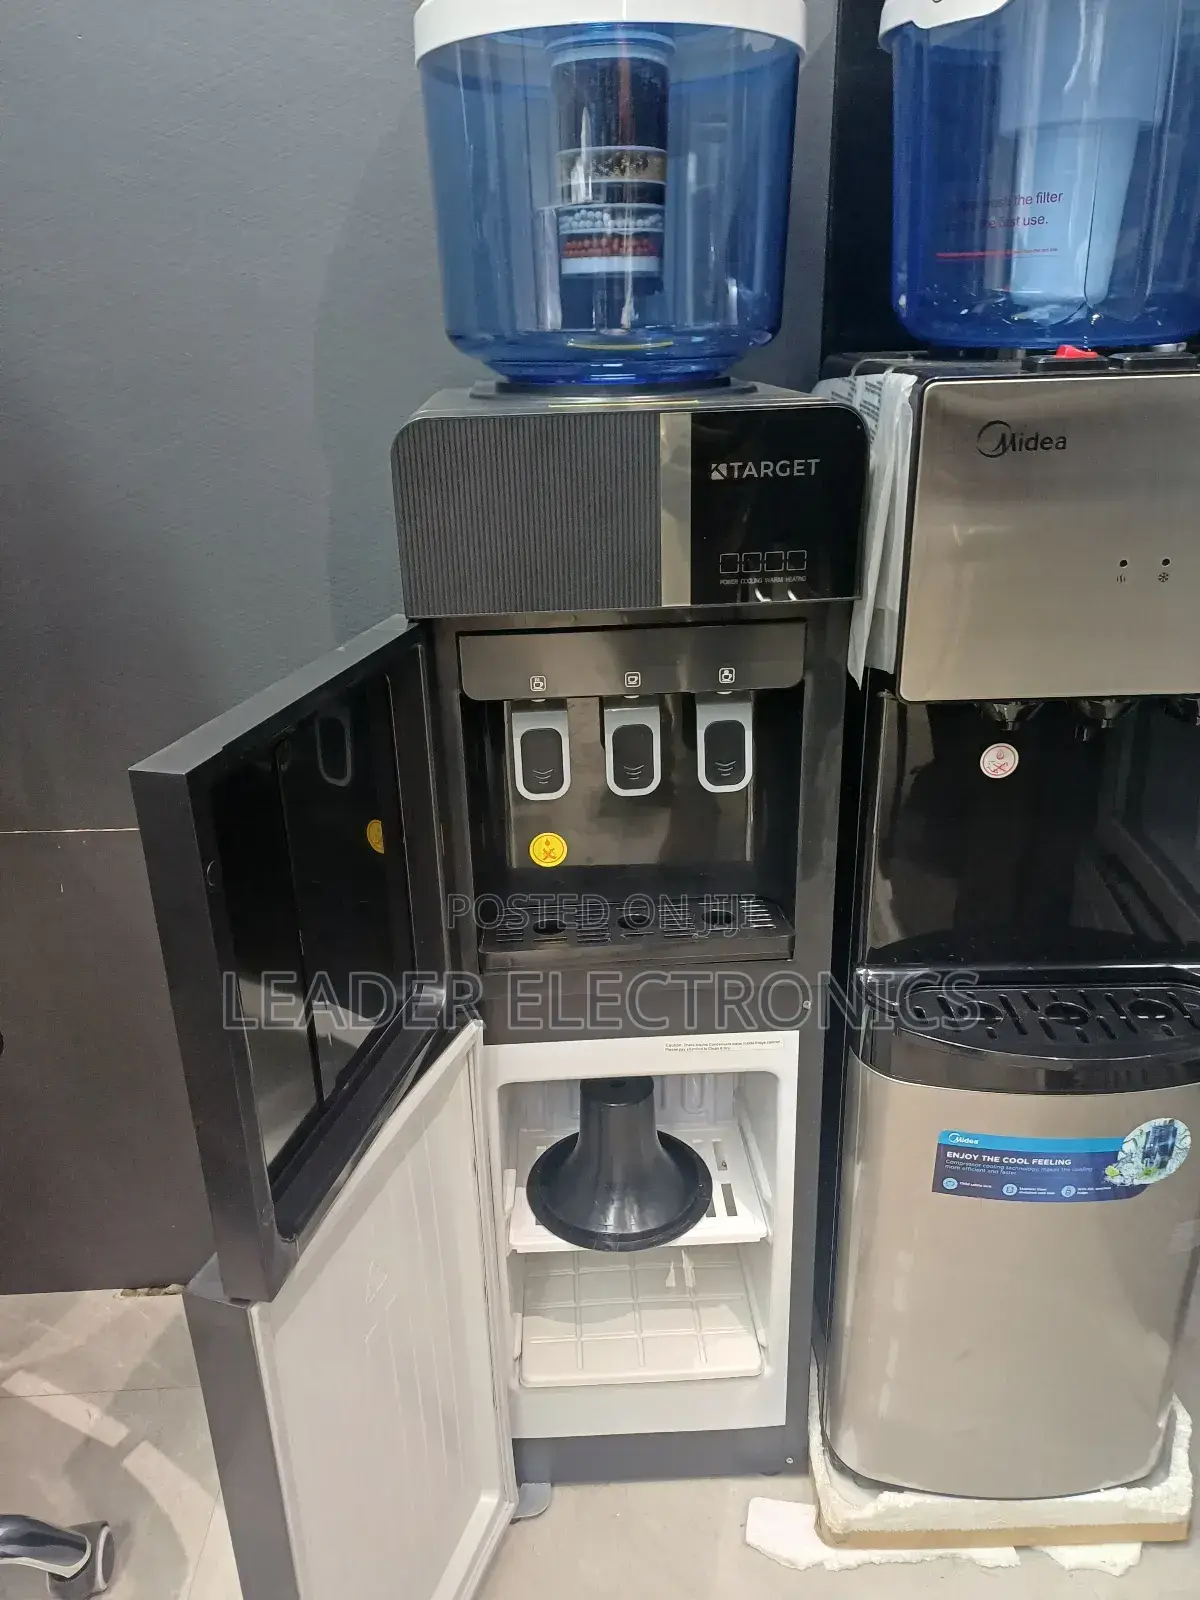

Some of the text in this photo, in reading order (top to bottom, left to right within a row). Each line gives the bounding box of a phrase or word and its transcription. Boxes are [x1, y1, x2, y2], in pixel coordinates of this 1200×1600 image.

[1036, 191, 1064, 204] filter
[1023, 215, 1049, 226] use.
[976, 420, 1067, 458] Midea
[948, 1132, 980, 1145] Midea
[946, 1151, 1072, 1166] ENJOY THE COOL FEELING
